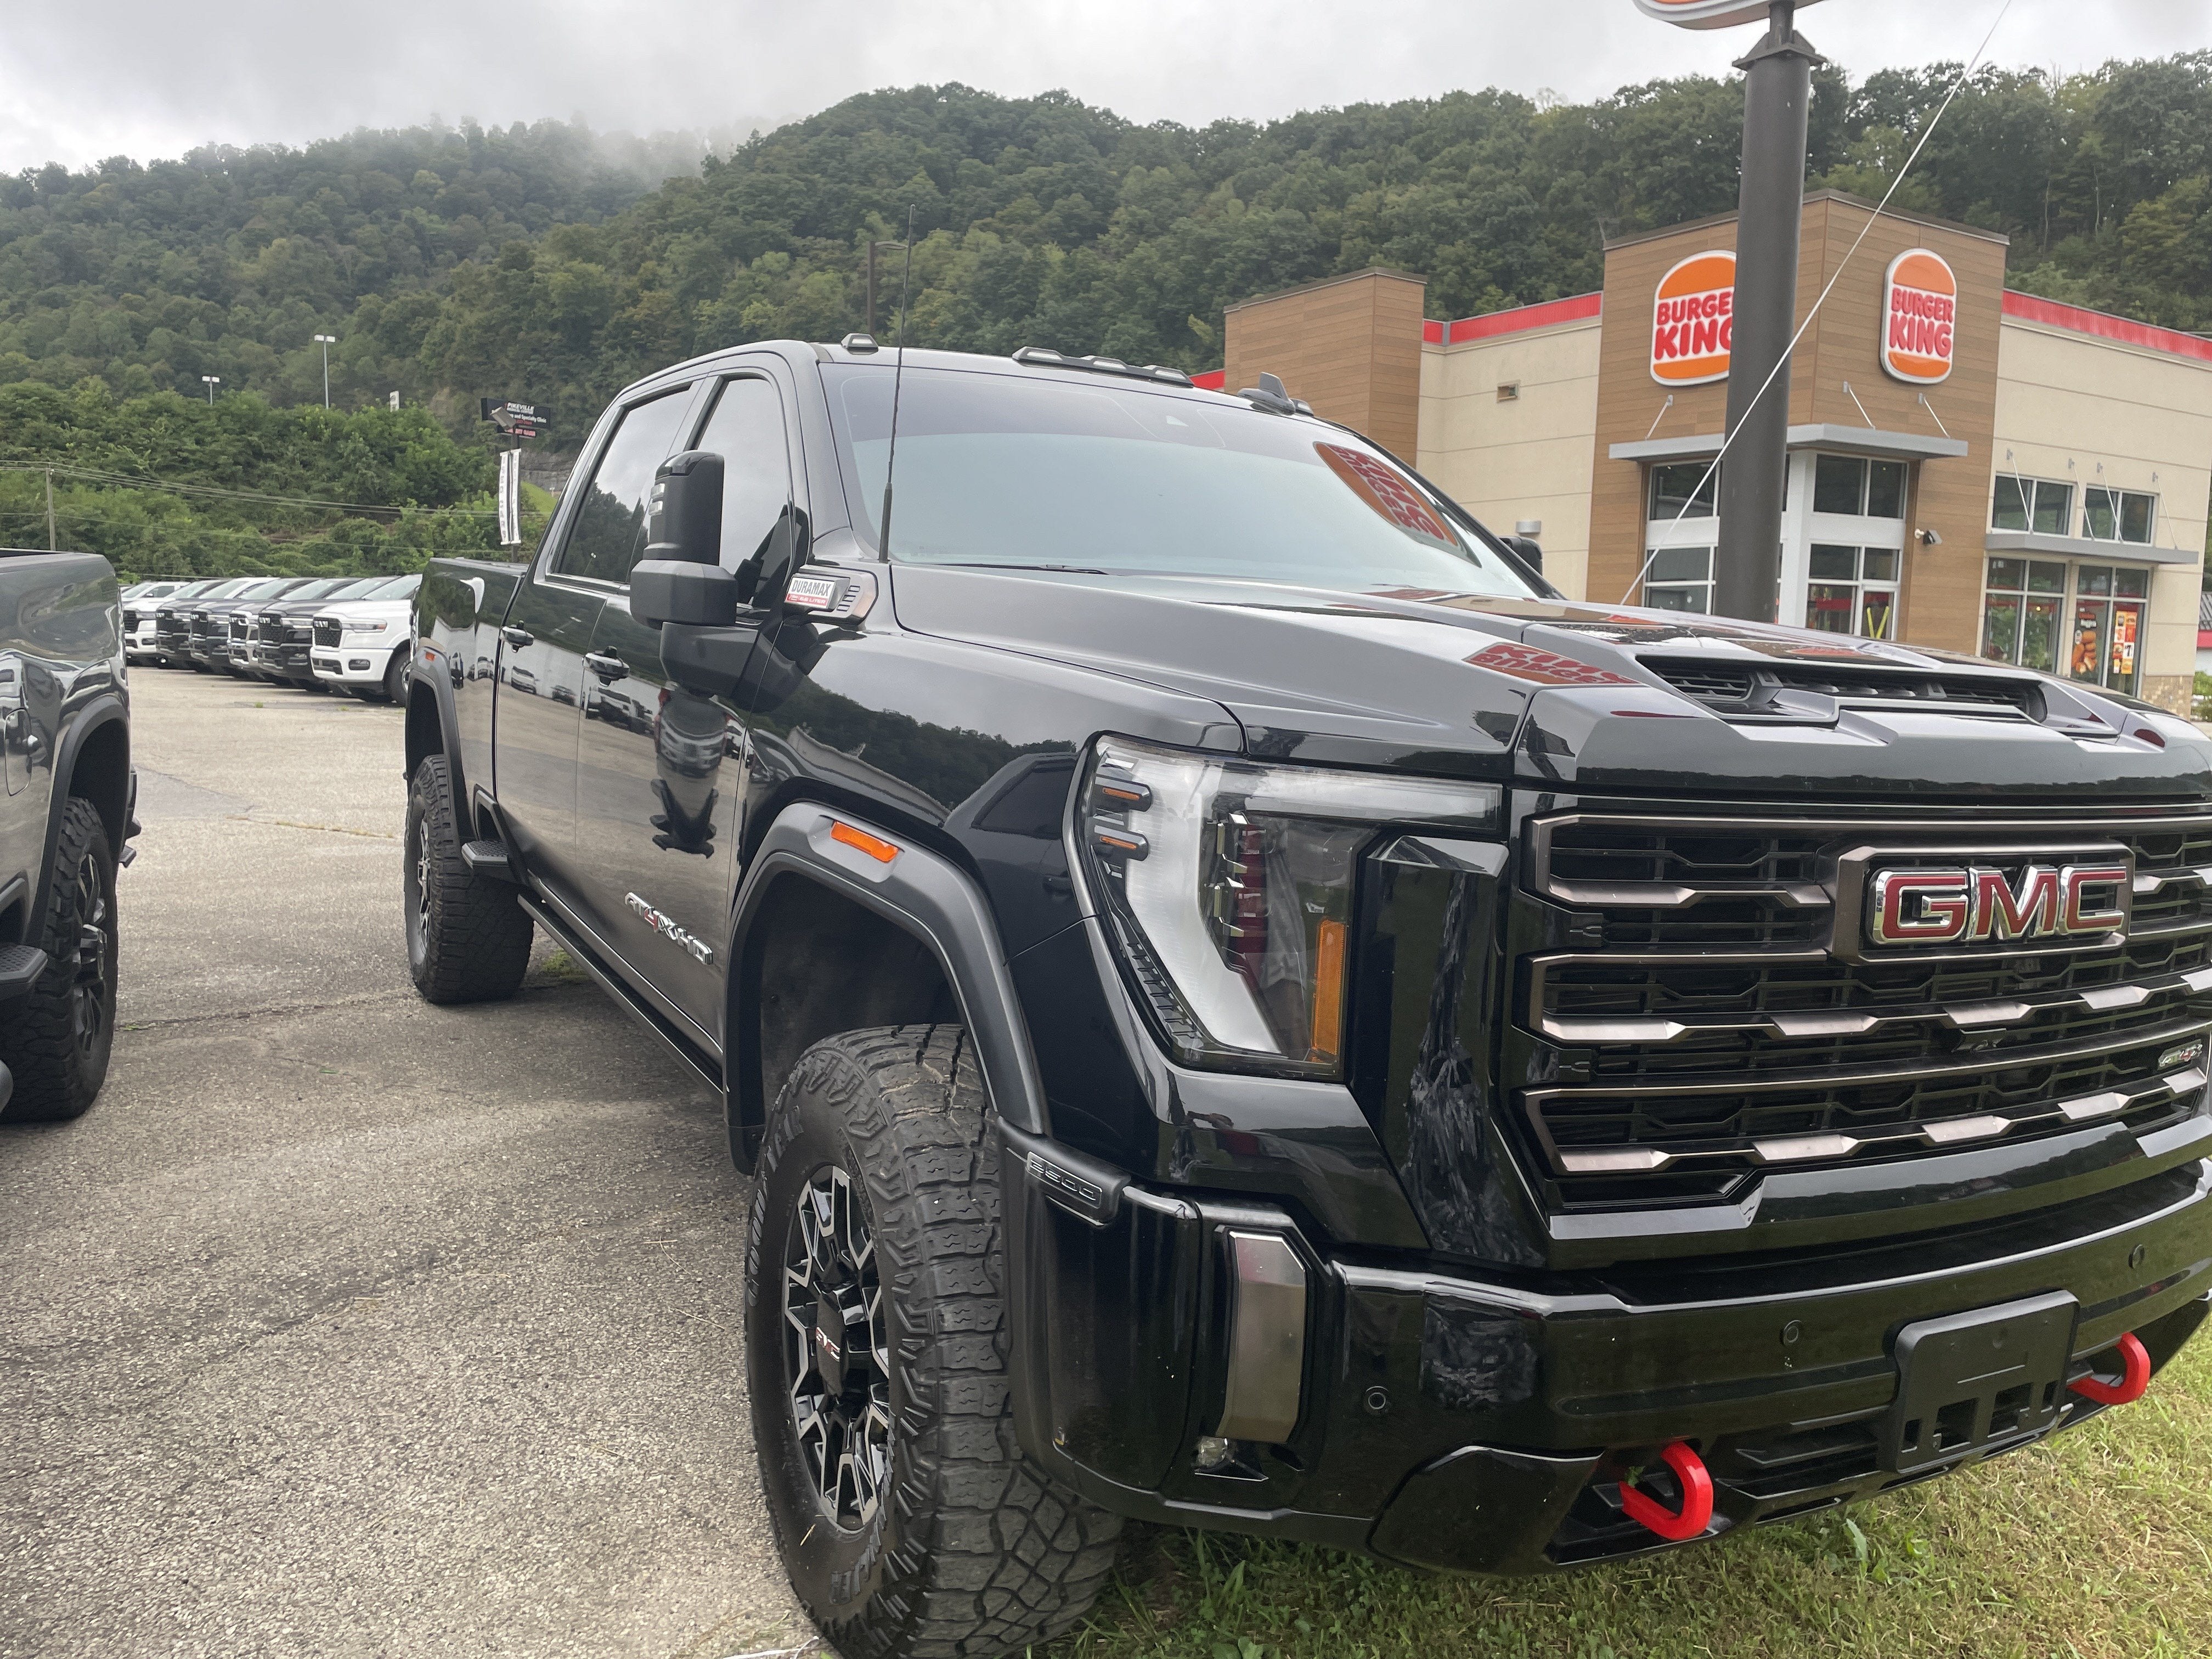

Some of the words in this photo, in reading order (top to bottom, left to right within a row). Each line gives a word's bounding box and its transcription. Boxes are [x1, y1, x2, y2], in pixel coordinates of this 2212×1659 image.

[1657, 291, 1732, 325] BURGE
[1892, 287, 1953, 323] BURGER
[1889, 313, 1951, 357] KING
[791, 579, 832, 596] DURAMAX
[1872, 865, 2128, 945] GMC
[1029, 1157, 1097, 1201] 2500
